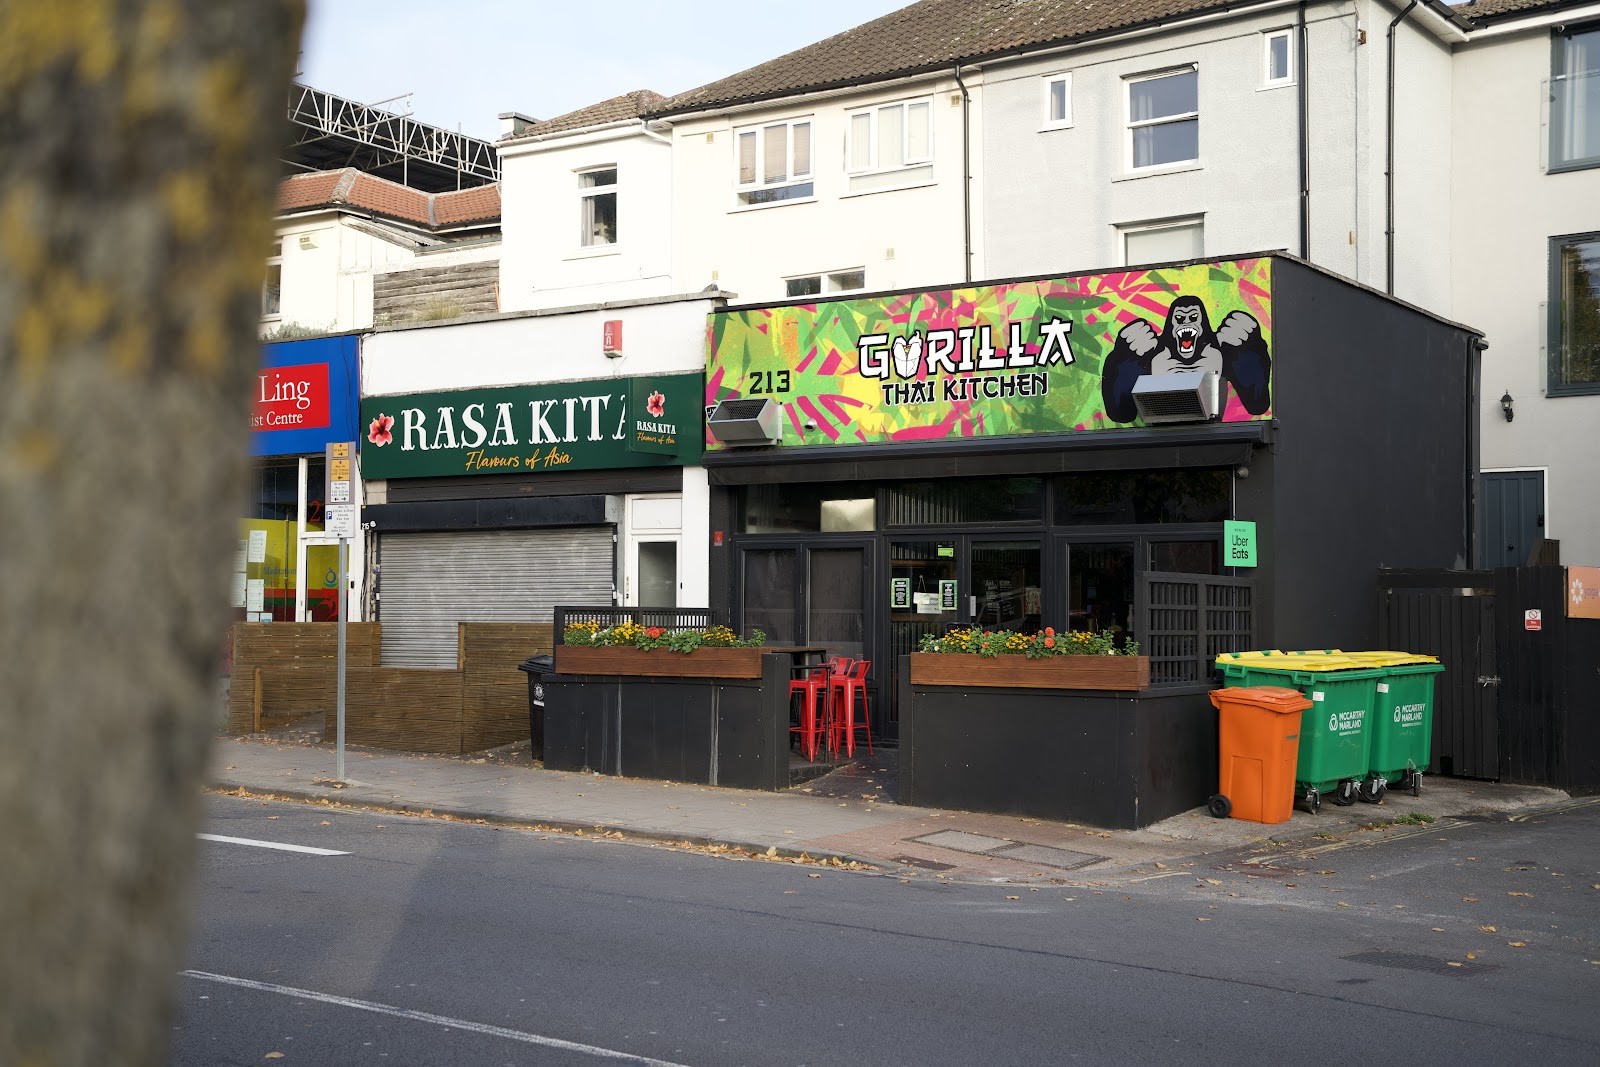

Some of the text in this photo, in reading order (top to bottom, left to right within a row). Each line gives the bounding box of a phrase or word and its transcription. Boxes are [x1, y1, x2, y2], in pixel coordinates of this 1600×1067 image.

[749, 370, 790, 395] 213
[882, 372, 1049, 406] THAI KITCHEN
[258, 374, 310, 410] Ling
[266, 411, 303, 426] Centre
[400, 402, 519, 451] RASA
[637, 420, 677, 435] RASA KITA
[465, 446, 573, 471] Flavours of Asia
[1232, 534, 1249, 546] Uber
[1232, 547, 1249, 560] Eats
[1339, 709, 1366, 721] MCCARTHY
[1402, 703, 1426, 713] MCCARTHY
[1402, 711, 1423, 722] MARLAND
[1339, 719, 1362, 730] MARLAND
